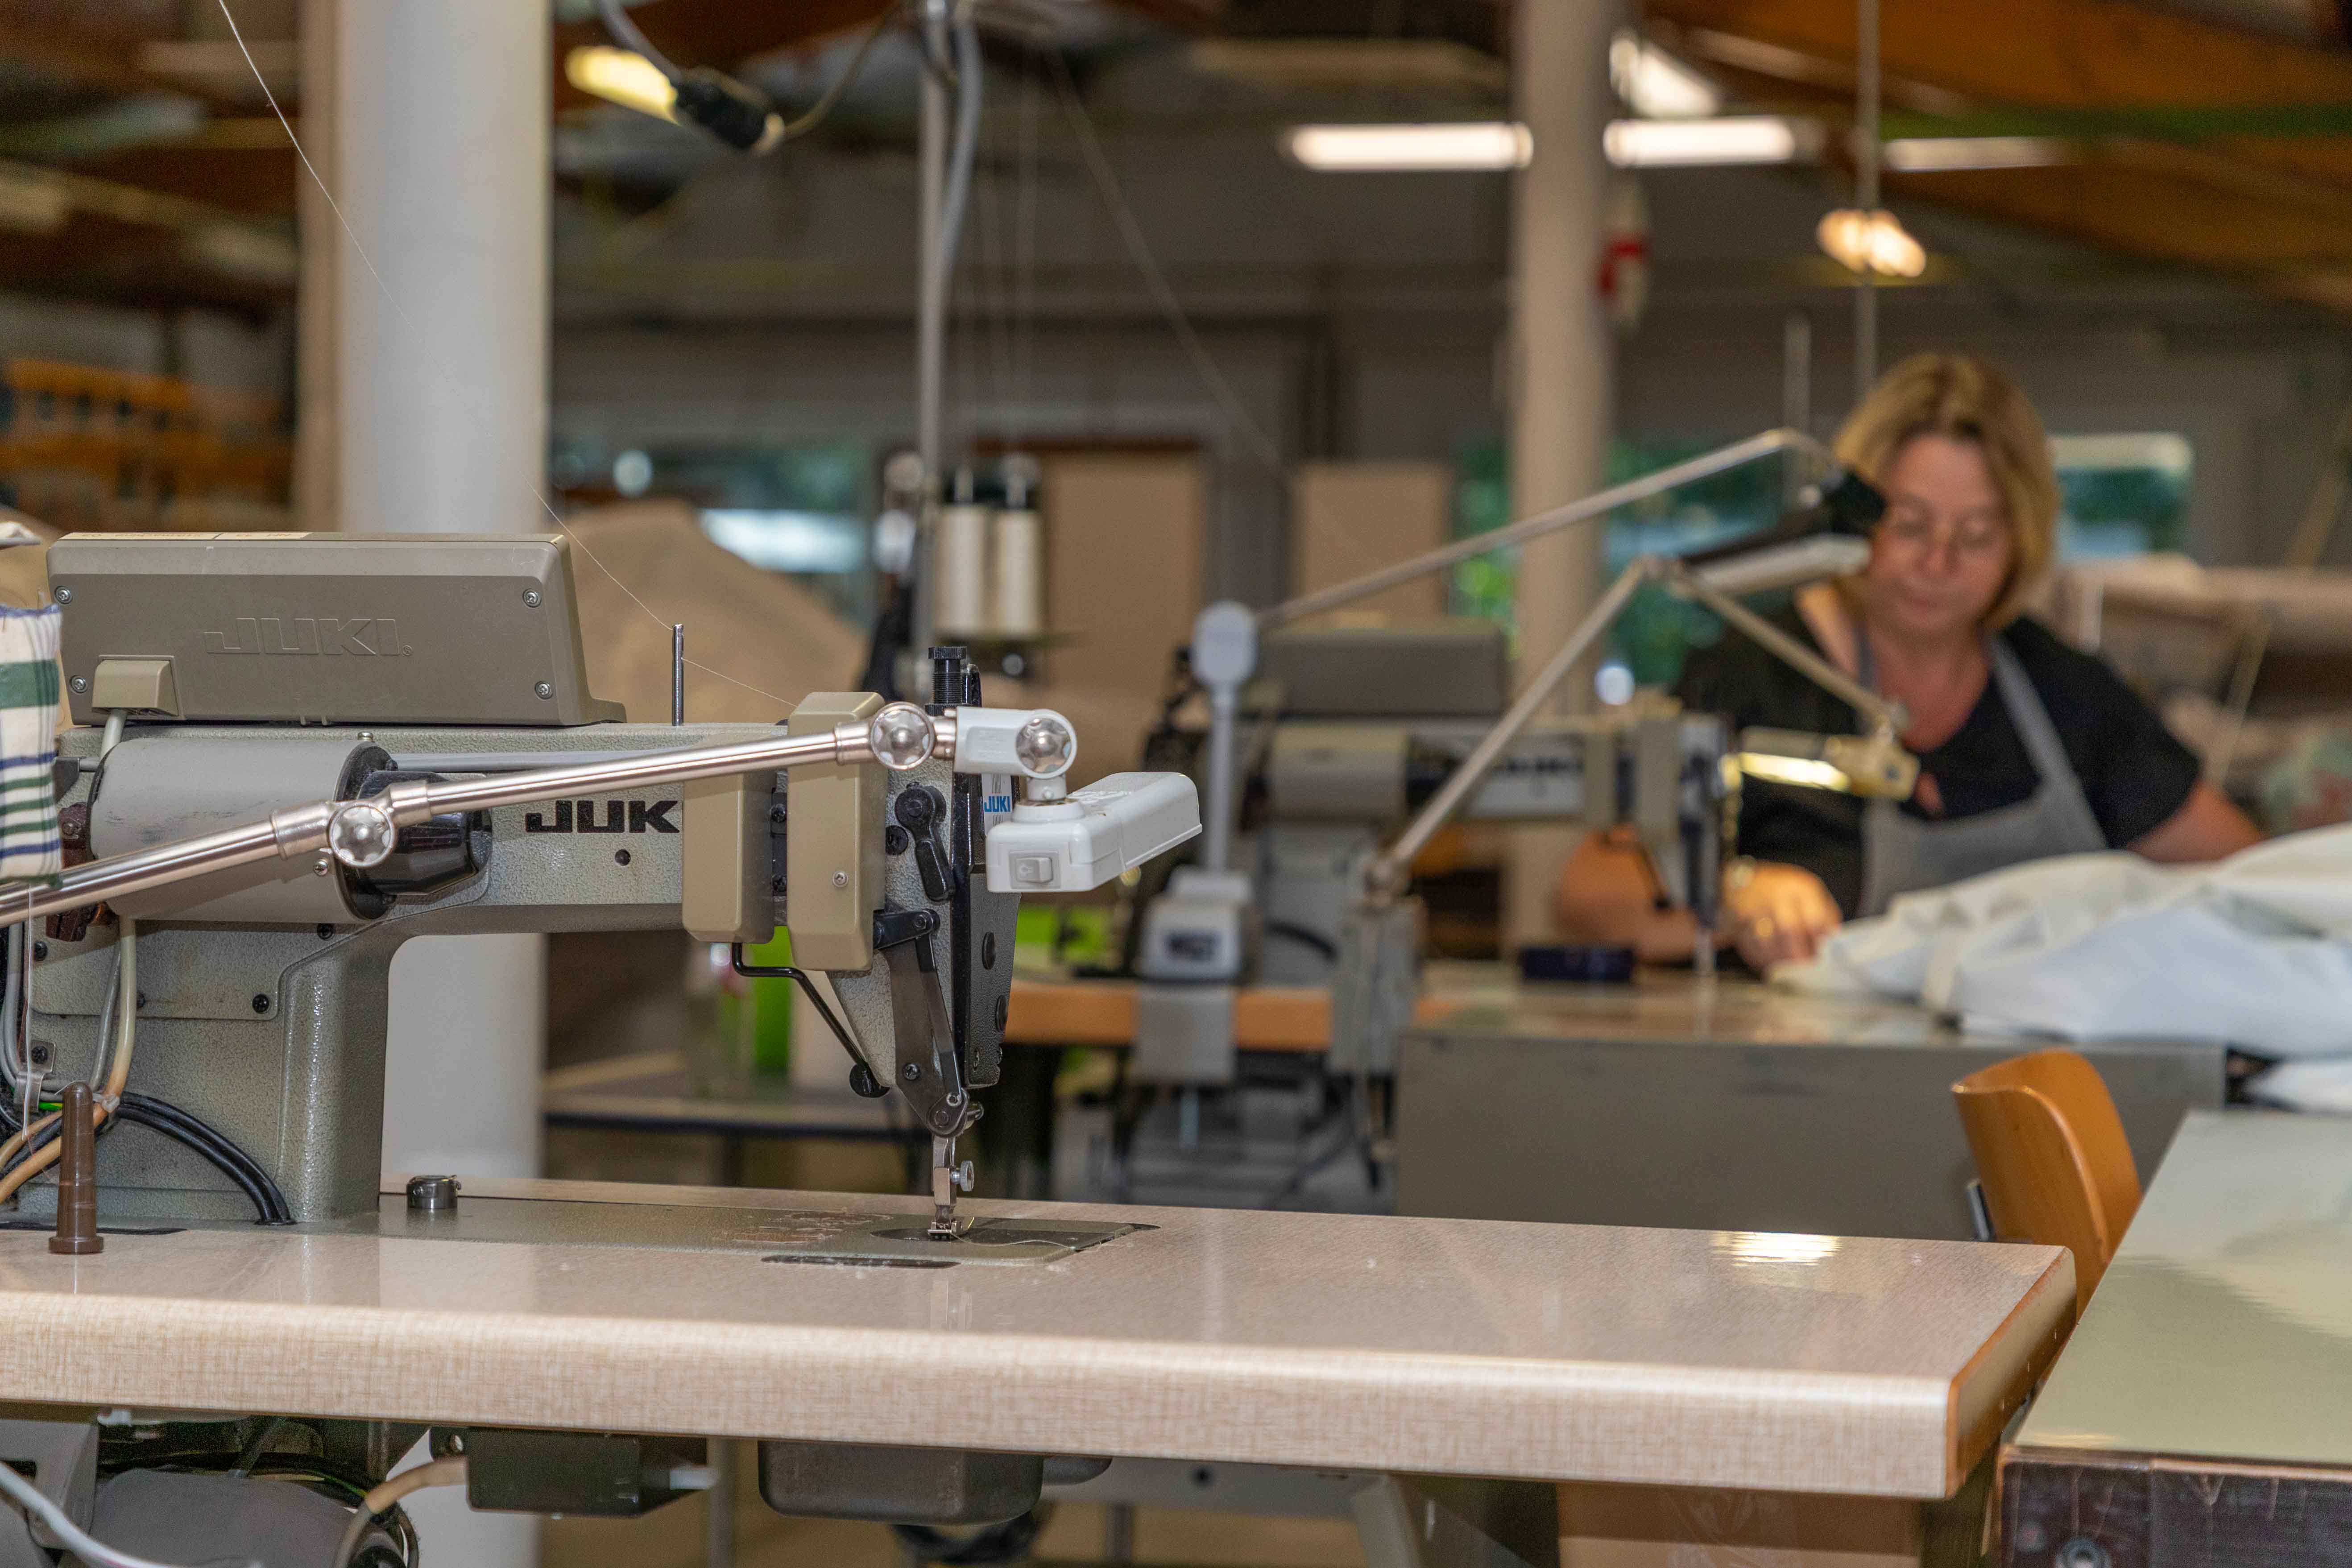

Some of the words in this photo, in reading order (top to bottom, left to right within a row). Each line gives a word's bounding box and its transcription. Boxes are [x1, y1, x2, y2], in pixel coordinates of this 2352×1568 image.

[203, 617, 400, 654] JUKI
[525, 800, 680, 833] JUK
[984, 795, 1010, 812] JUKI
